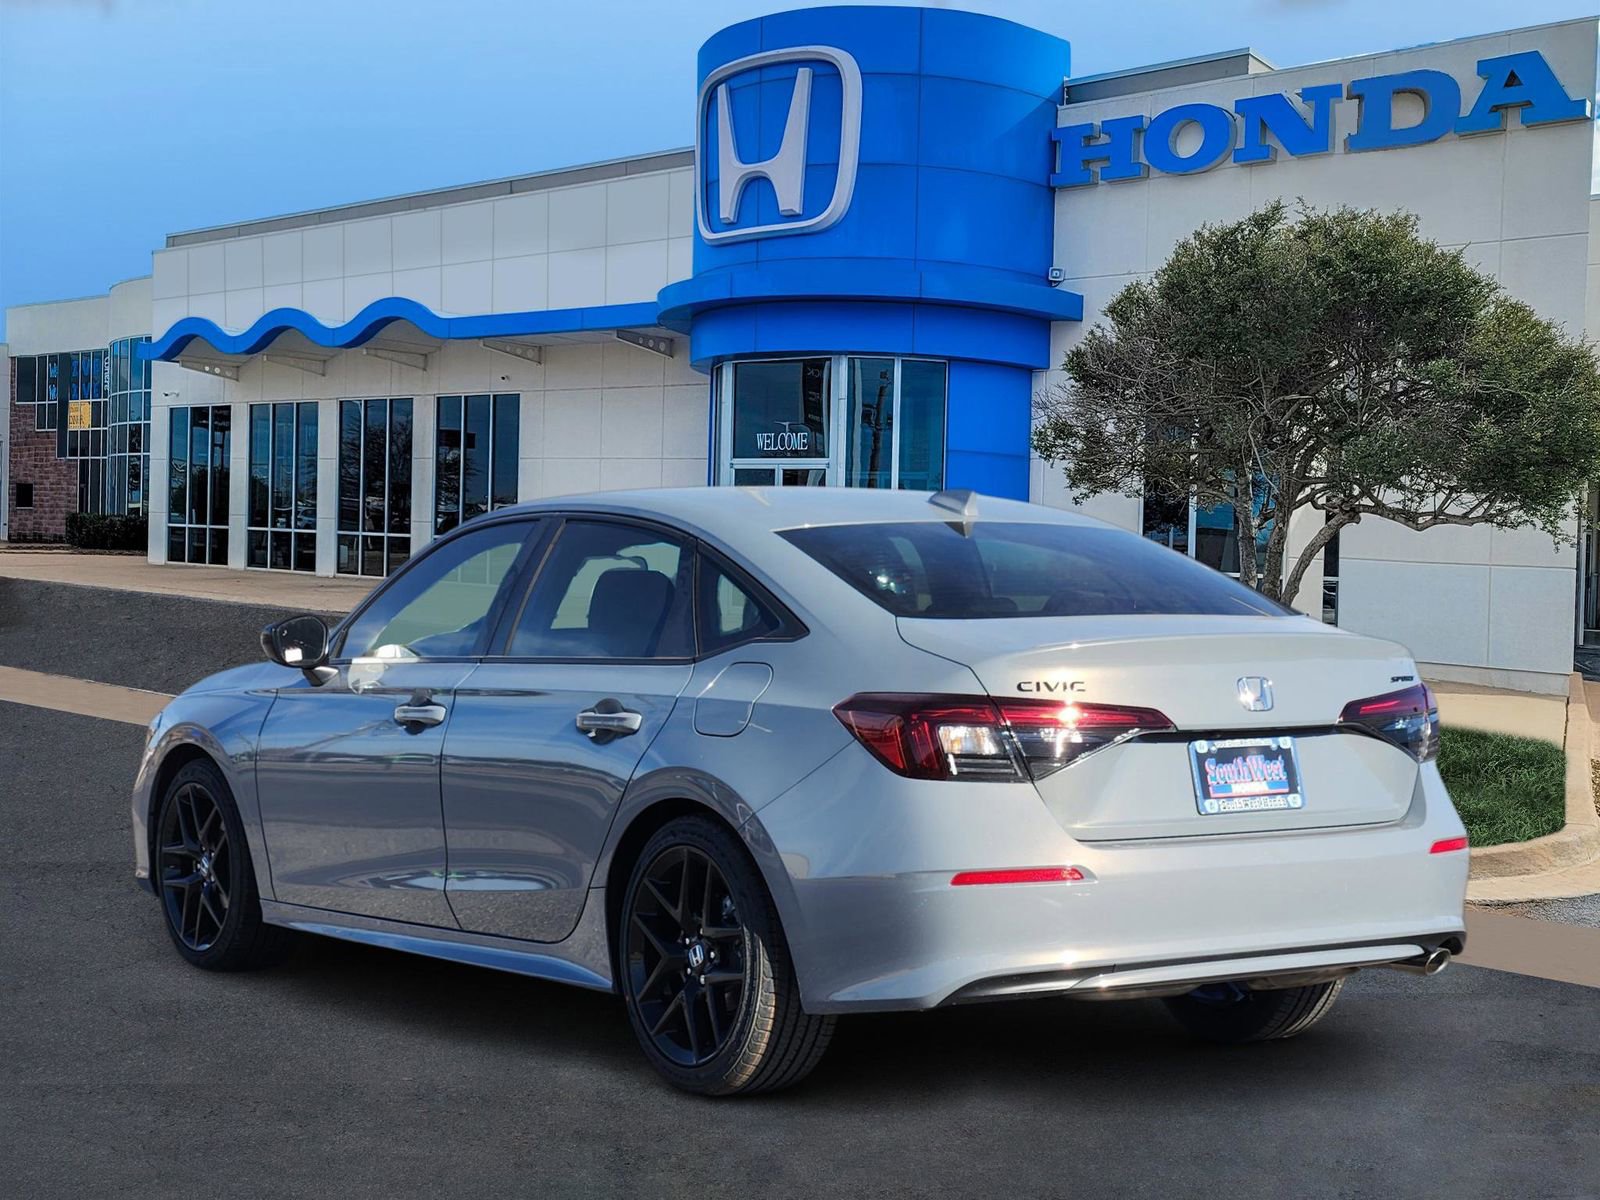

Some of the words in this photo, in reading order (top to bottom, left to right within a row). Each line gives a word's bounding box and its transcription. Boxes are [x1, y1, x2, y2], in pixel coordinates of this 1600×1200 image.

[1050, 50, 1591, 188] HONDA
[757, 432, 808, 451] WELCOME
[1016, 681, 1086, 692] CIVIC
